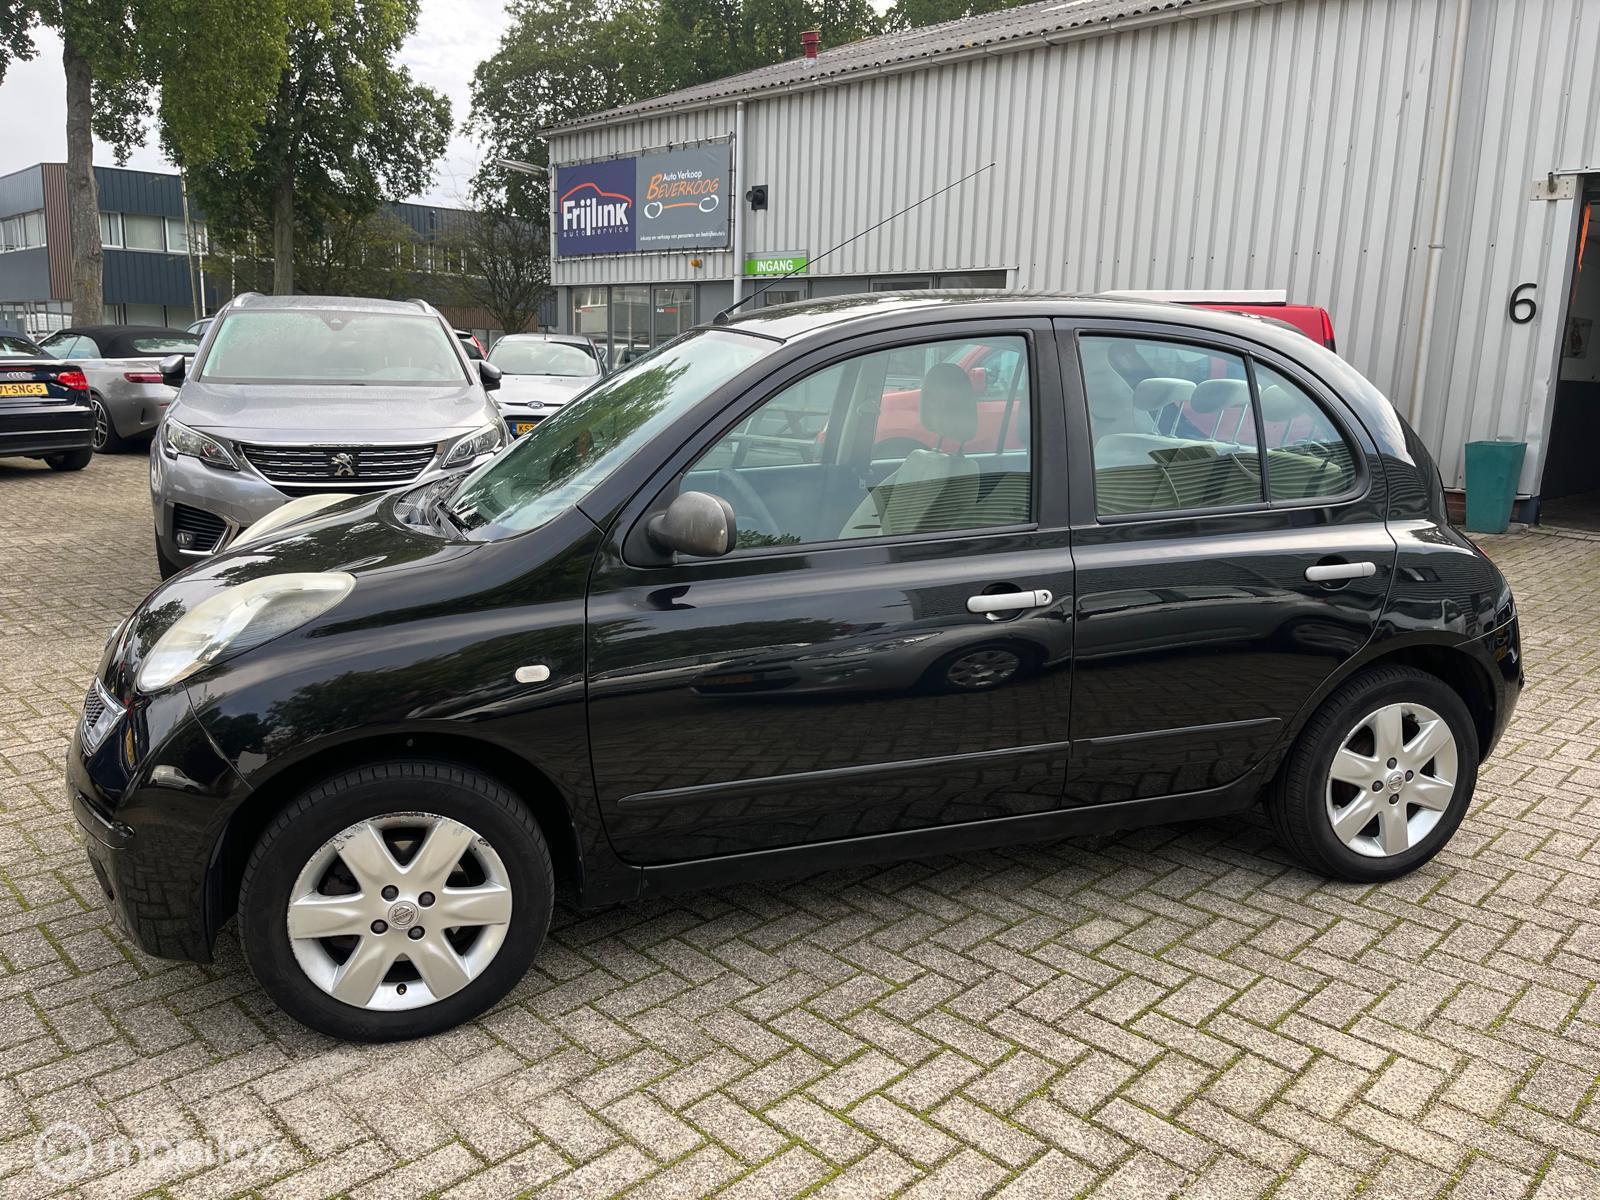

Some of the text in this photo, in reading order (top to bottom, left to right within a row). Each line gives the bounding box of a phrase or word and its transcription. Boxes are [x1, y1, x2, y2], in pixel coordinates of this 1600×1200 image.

[646, 173, 720, 200] BEVERKOOG
[663, 170, 703, 181] Auto Verkoop
[563, 198, 629, 236] Frijlink
[757, 260, 793, 272] INGANG
[1509, 282, 1537, 324] 6
